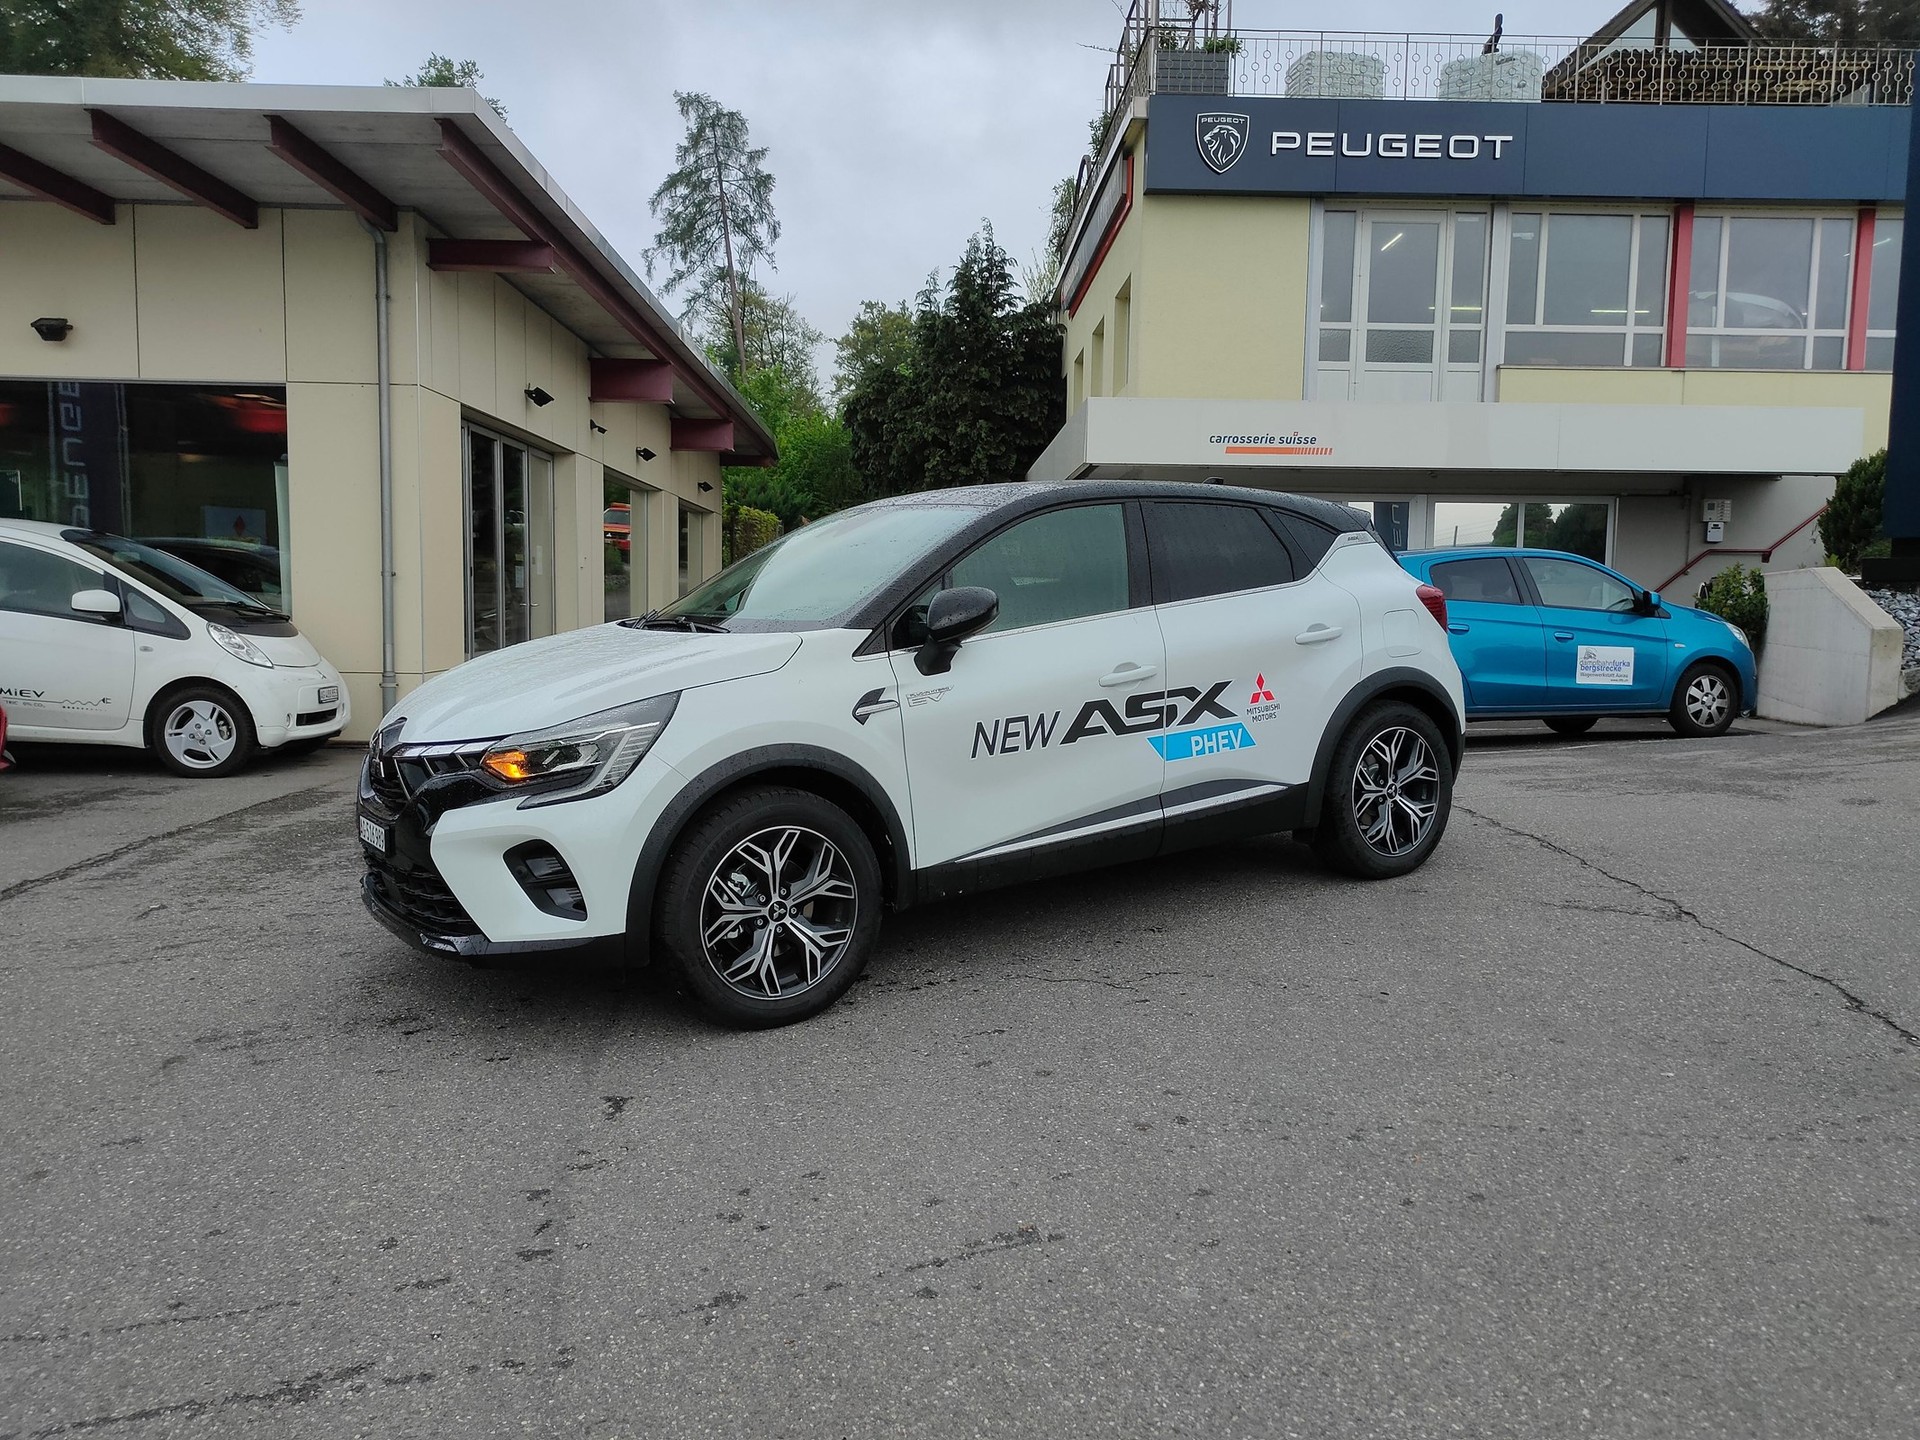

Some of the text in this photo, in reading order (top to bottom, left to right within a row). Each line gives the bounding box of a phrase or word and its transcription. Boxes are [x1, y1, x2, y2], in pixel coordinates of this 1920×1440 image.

[1271, 131, 1513, 159] PEUGEOT
[1209, 432, 1317, 445] carrosserie suisse
[1580, 664, 1622, 672] bergstrecke
[1246, 703, 1281, 715] MITSUBISHI
[971, 679, 1239, 759] NEW ASX
[1251, 712, 1277, 723] MOTORS
[1191, 728, 1243, 757] PHEV
